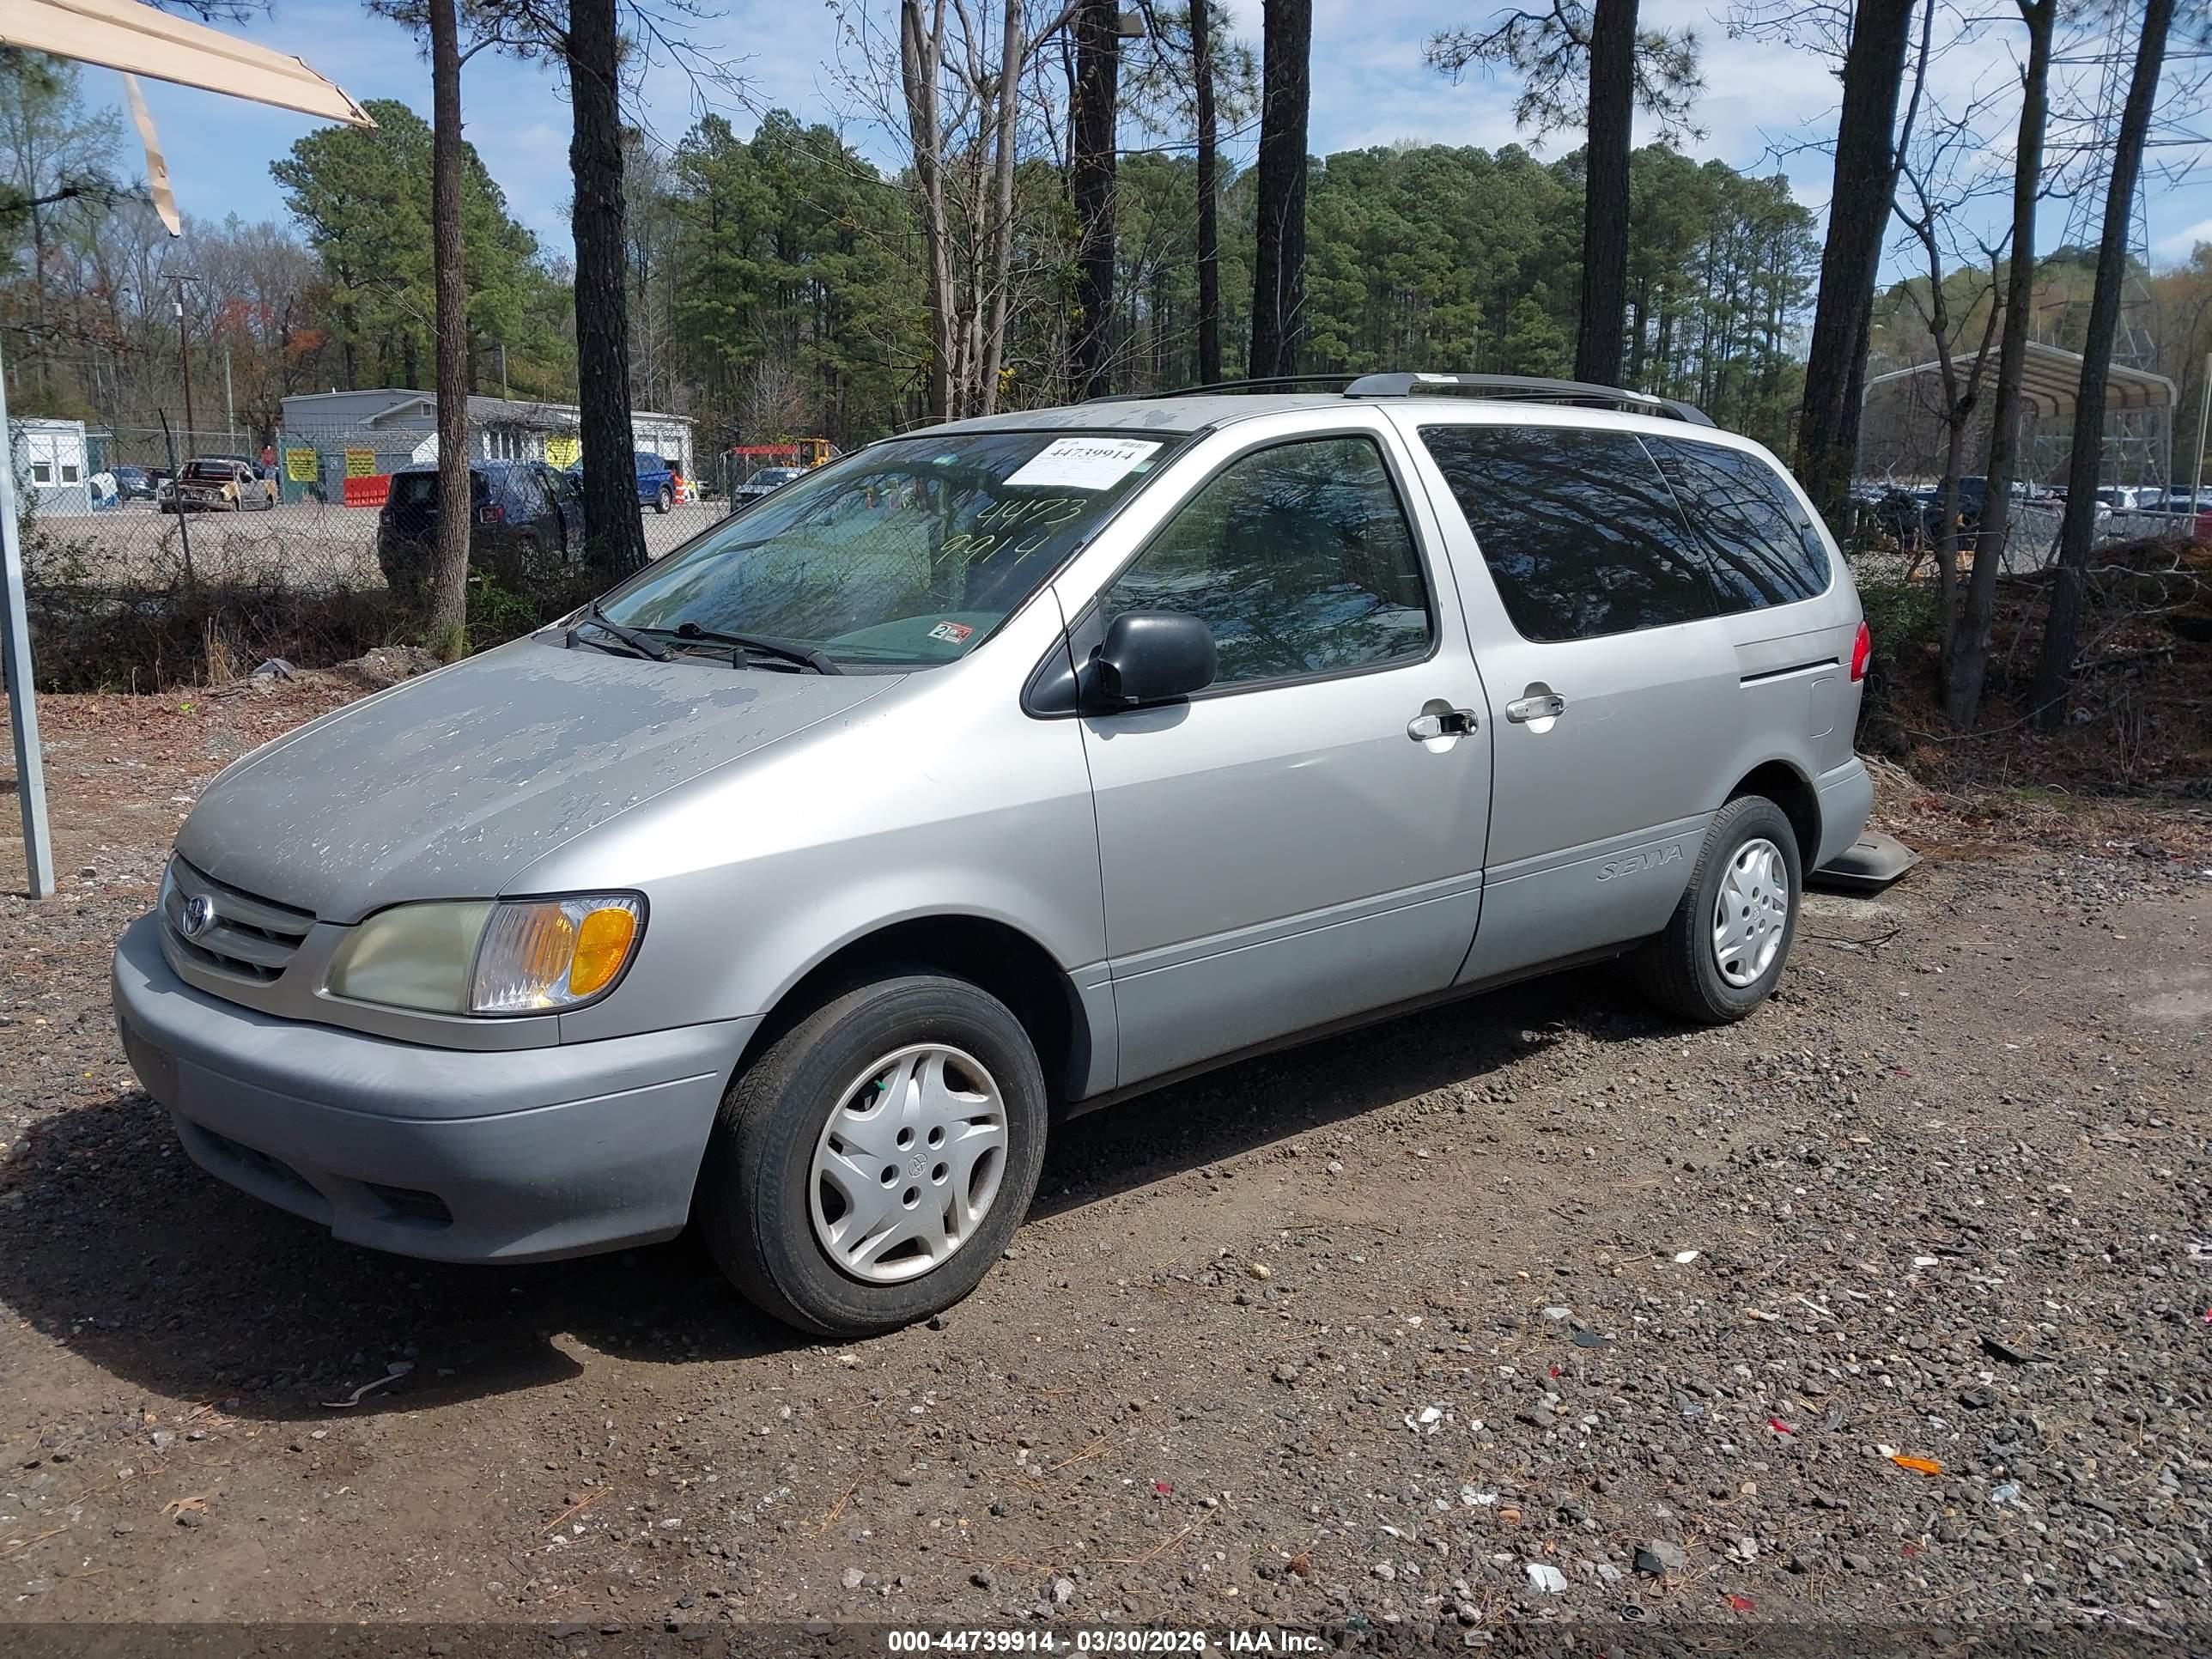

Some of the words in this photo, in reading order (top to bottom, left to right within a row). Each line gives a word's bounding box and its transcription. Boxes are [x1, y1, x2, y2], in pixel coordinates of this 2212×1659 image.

[1050, 447, 1136, 460] 44739914
[976, 498, 1088, 531] 4473
[935, 533, 1050, 566] 9914
[933, 625, 948, 636] 2
